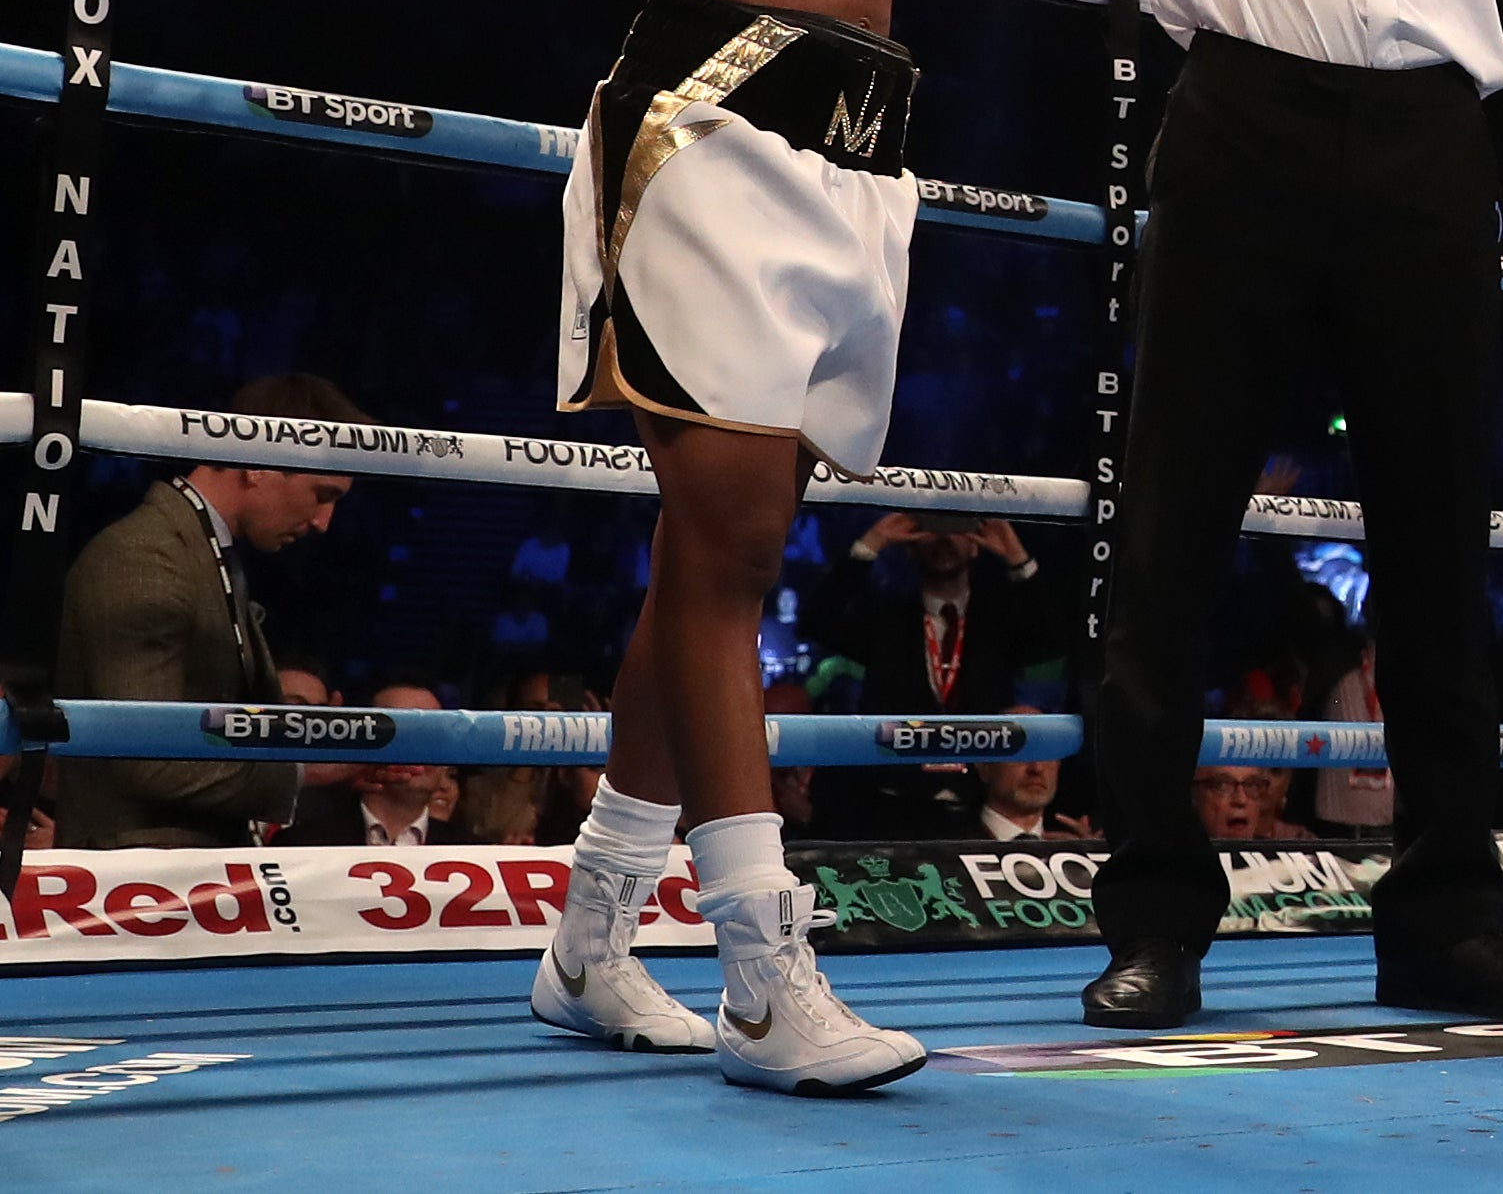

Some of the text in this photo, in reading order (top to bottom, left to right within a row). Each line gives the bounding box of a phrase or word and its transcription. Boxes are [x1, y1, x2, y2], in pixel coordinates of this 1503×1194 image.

[266, 88, 416, 129] BT Sport
[918, 179, 1035, 213] BT Sport
[1108, 58, 1137, 322] BT Sport
[20, 173, 90, 534] NATION
[1087, 372, 1120, 639] BT Sport
[224, 713, 376, 744] BT Sport
[502, 715, 608, 752] FRANK
[893, 725, 1011, 752] BT Sport
[1220, 727, 1298, 758] FRANK
[0, 862, 301, 941] Red .com
[1072, 1032, 1443, 1068] BT
